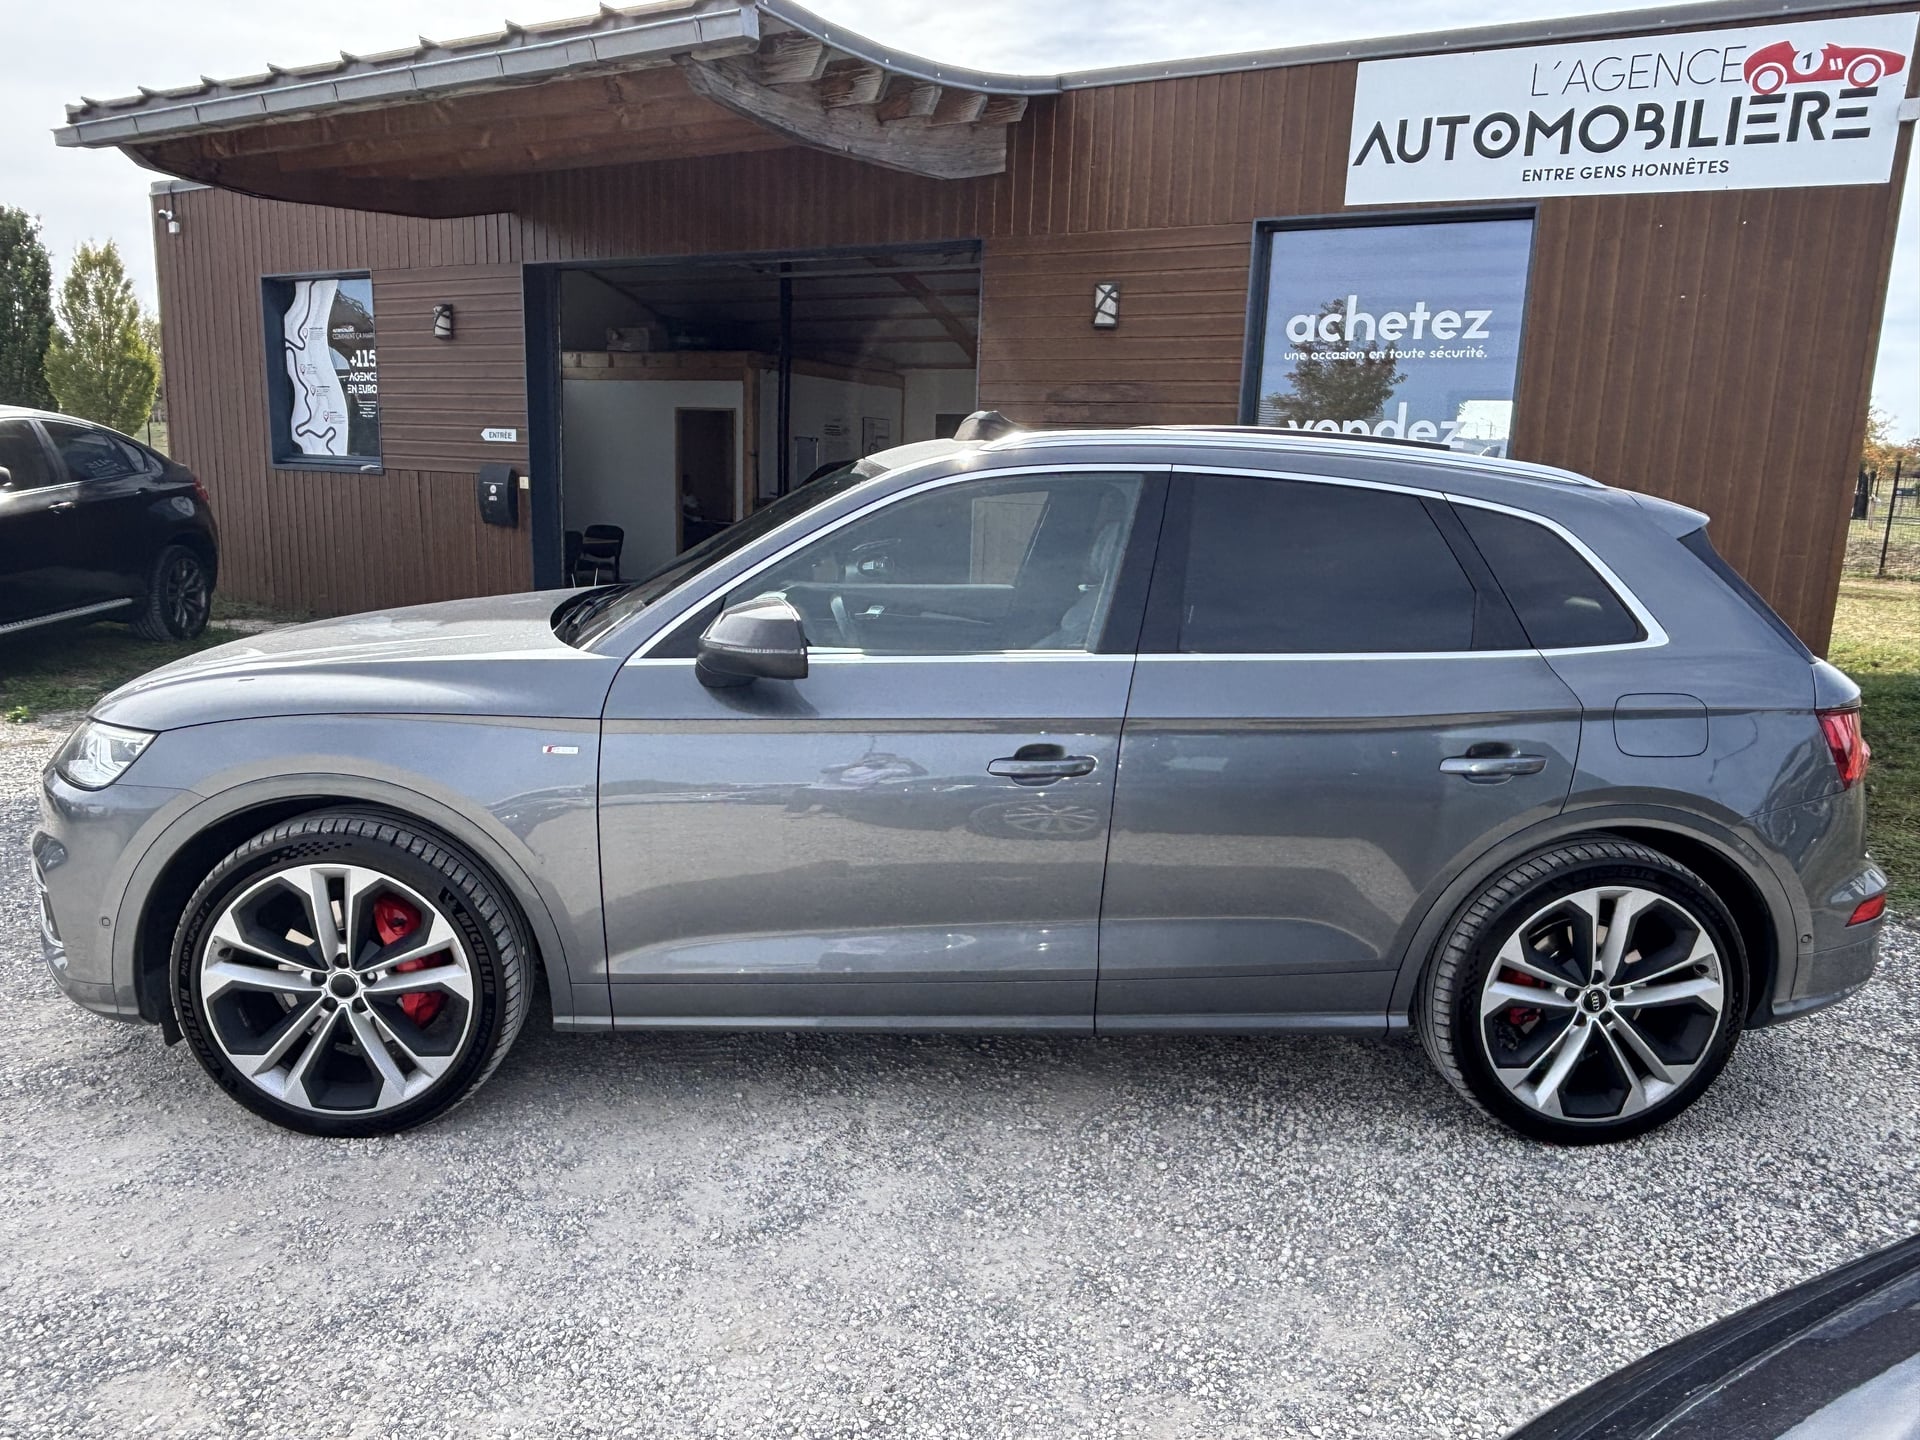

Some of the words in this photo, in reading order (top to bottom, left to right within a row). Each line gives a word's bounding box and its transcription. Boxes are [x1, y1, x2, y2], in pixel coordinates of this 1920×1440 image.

[1522, 167, 1575, 182] ENTRE
[1580, 164, 1627, 180] GENS
[1632, 157, 1730, 178] HONNÊTES
[1285, 294, 1494, 343] achetez
[1284, 352, 1307, 361] une
[1310, 347, 1365, 361] occasion
[1368, 351, 1385, 360] en
[1389, 348, 1425, 359] toute
[1430, 344, 1489, 359] sécurité.
[347, 384, 357, 394] EN
[488, 431, 513, 439] ENTRÉE
[455, 909, 495, 995] MICHELIN
[179, 987, 221, 1070] MICHELIN
